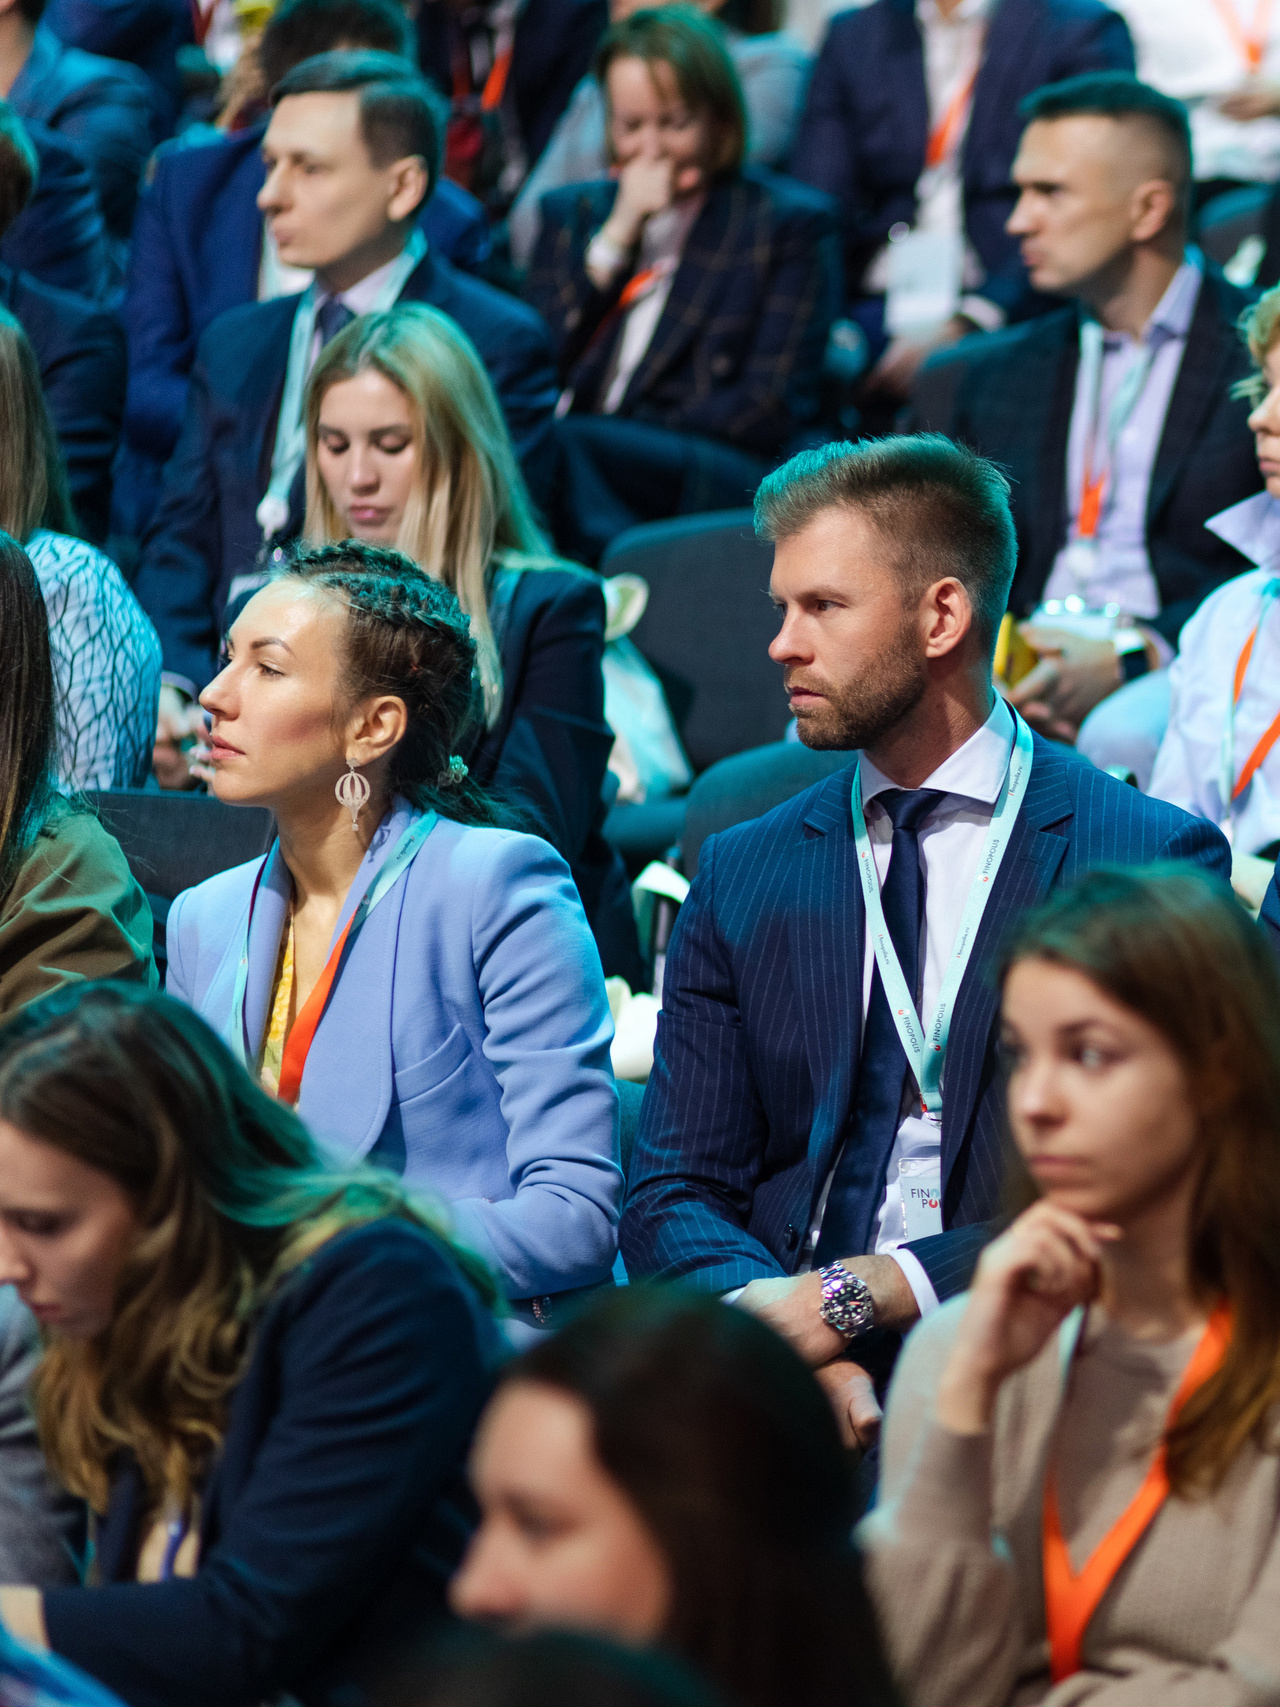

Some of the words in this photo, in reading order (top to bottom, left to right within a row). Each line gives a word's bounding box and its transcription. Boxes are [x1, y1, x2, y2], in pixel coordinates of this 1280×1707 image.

[983, 838, 1000, 874] FINOPOLIS
[902, 1016, 920, 1053] FINOPOLIS
[933, 1003, 946, 1042] FINOPOLIS
